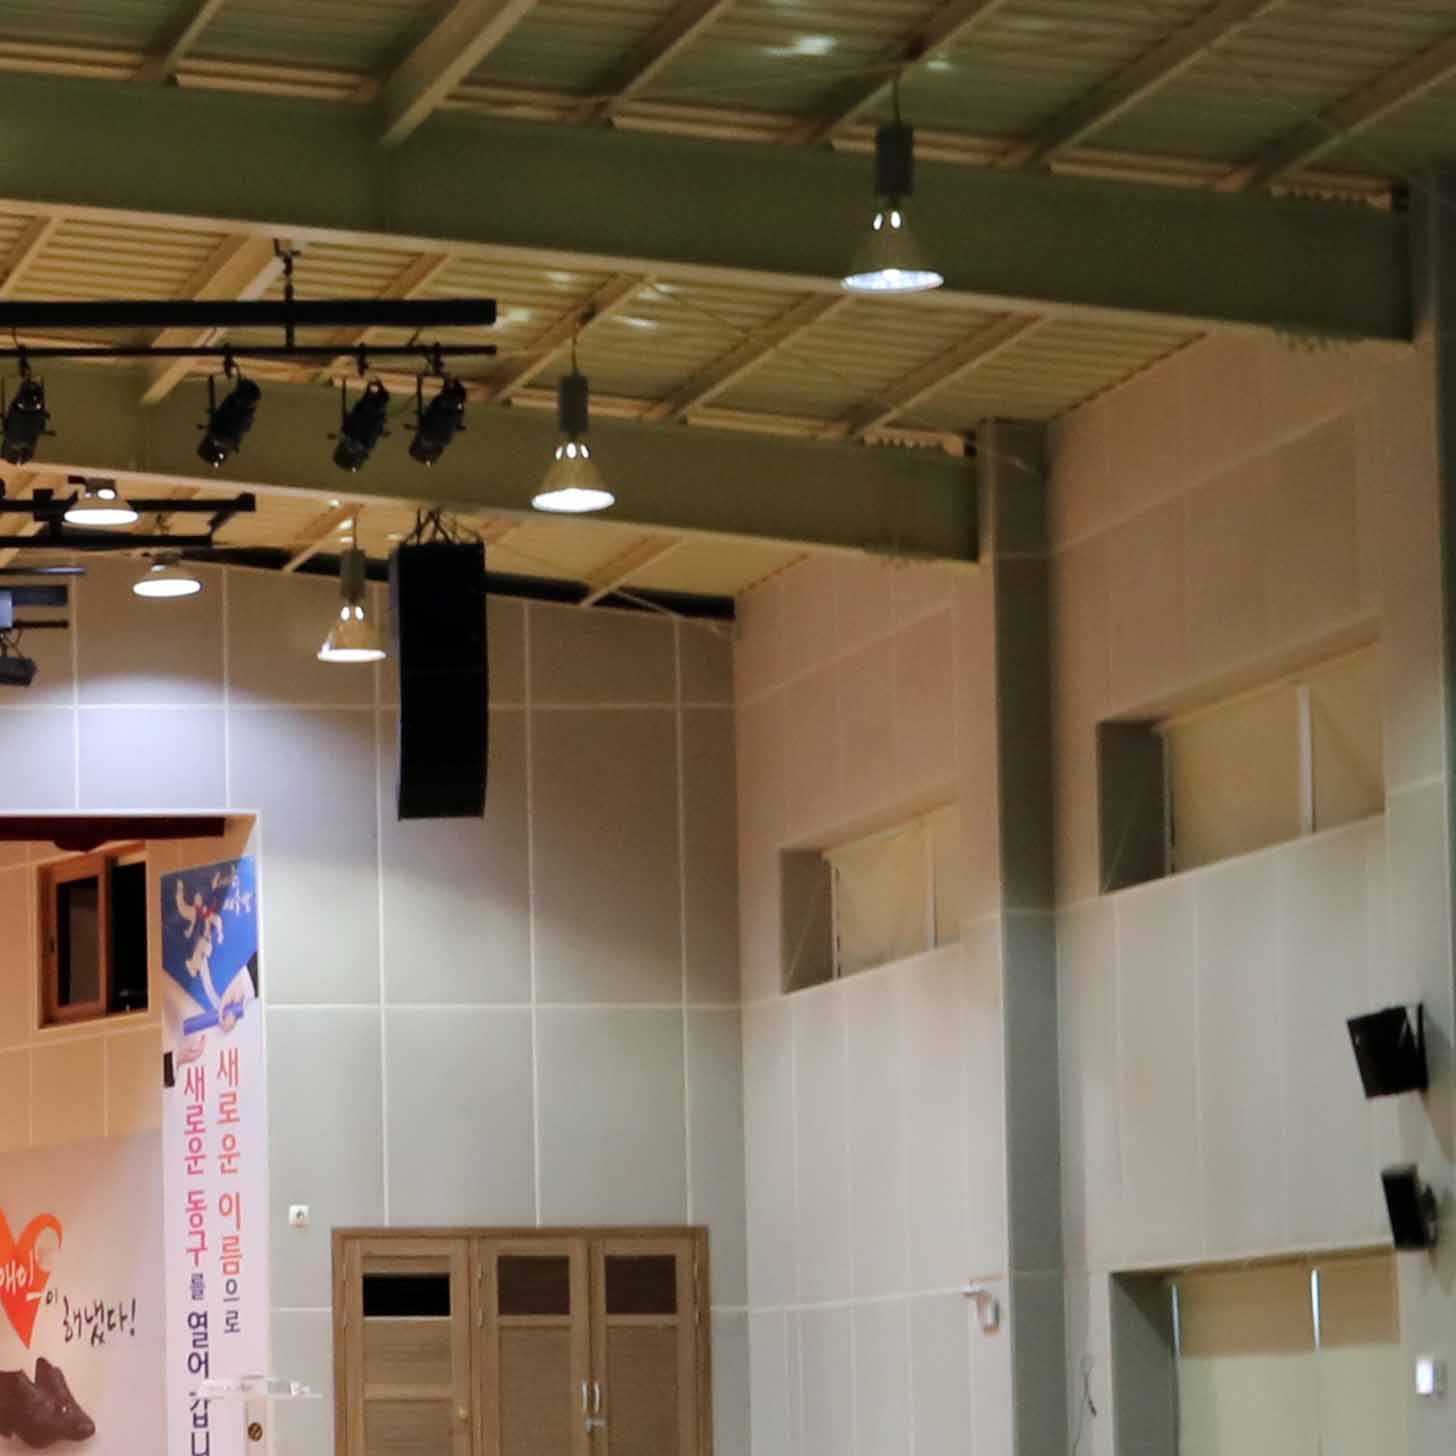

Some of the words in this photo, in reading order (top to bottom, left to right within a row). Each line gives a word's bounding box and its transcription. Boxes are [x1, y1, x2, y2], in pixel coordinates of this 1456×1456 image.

[183, 1066, 208, 1176] 새로운
[216, 1047, 241, 1177] 새로운
[185, 1189, 209, 1302] 동구를
[218, 1191, 242, 1336] 이름으로
[187, 1310, 210, 1380] 열어
